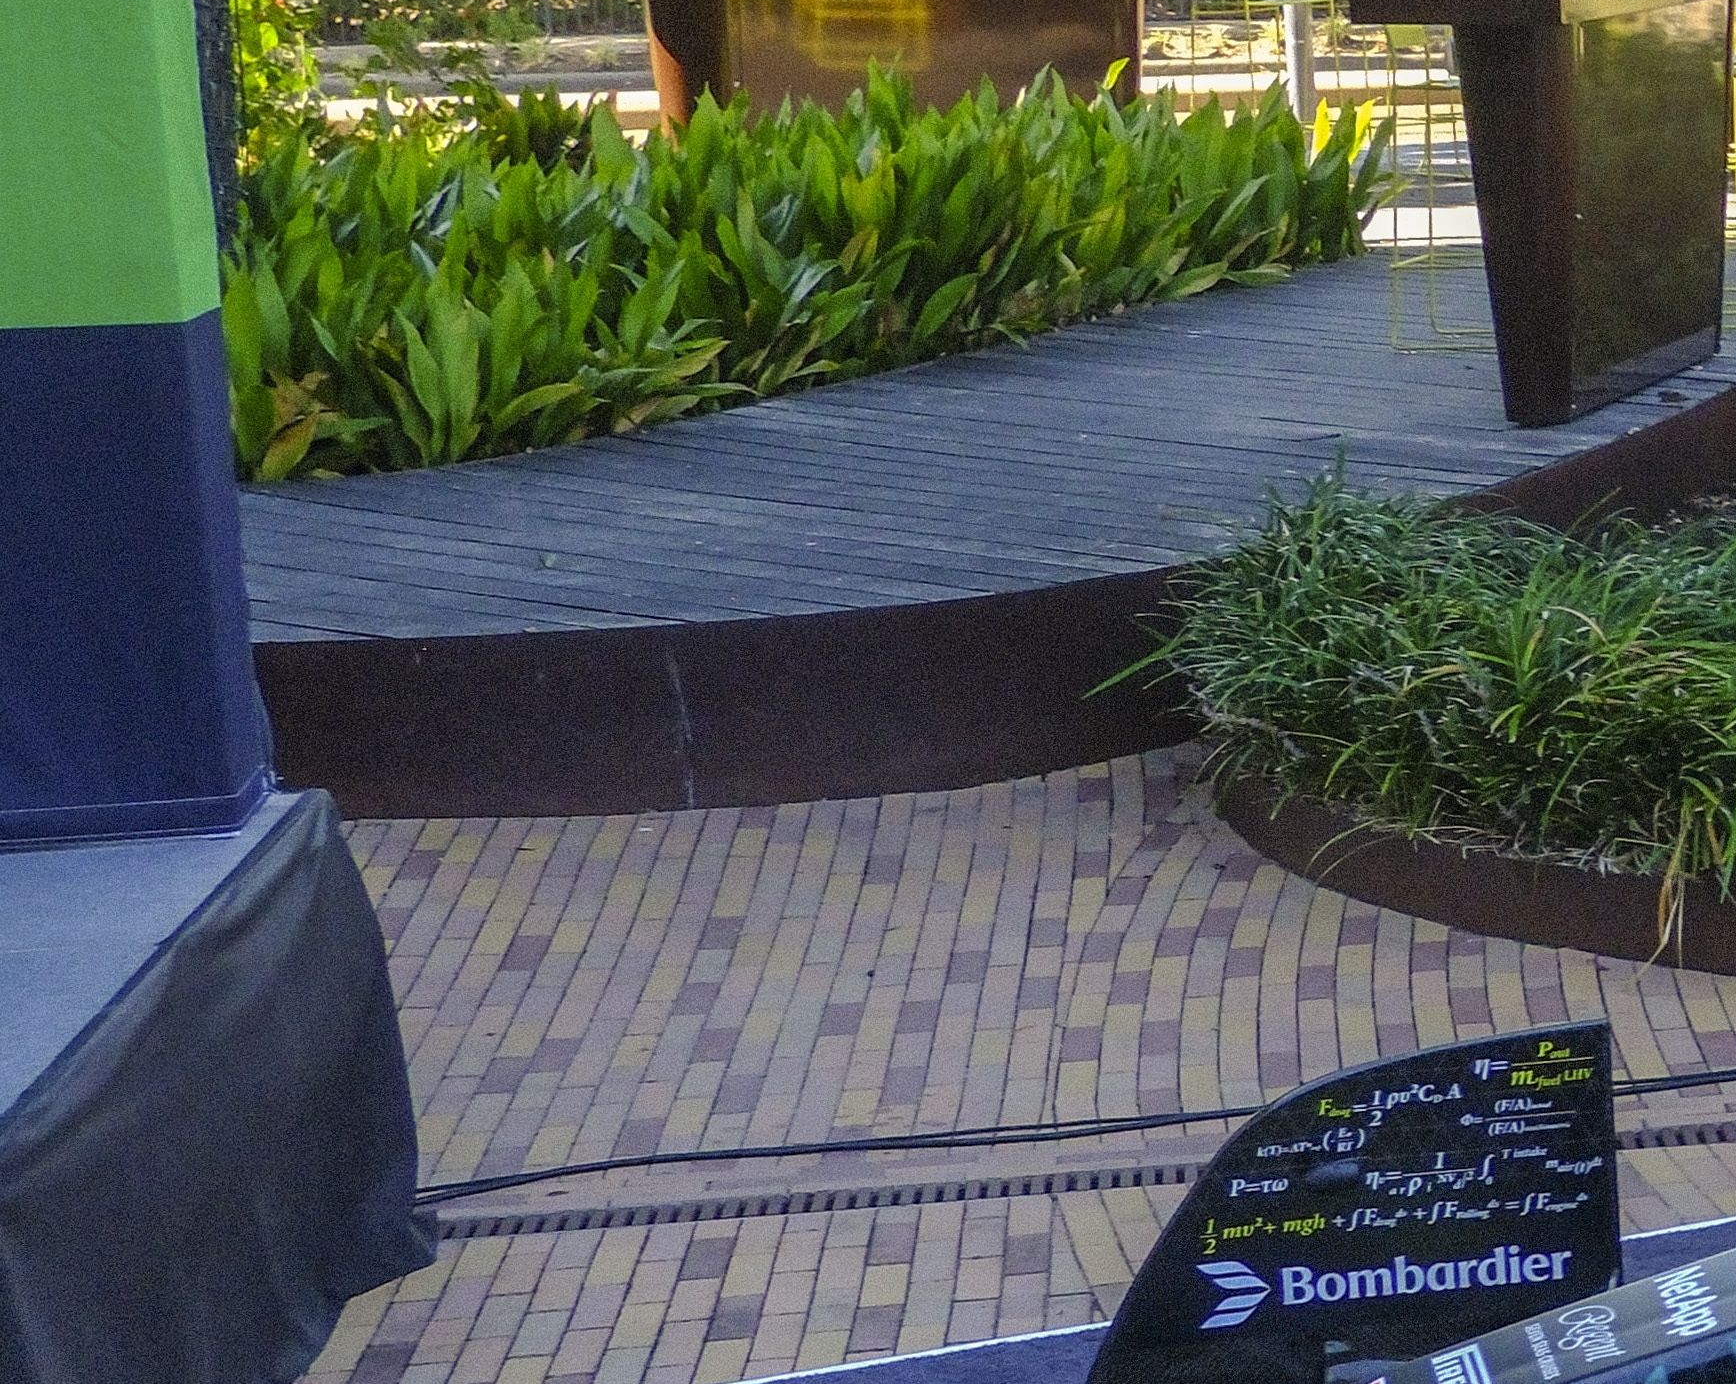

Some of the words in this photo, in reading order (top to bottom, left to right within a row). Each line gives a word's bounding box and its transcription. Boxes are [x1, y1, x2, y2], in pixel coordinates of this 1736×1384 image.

[1280, 1243, 1574, 1308] Bombardier
[1652, 1267, 1720, 1339] NetApp
[1557, 1304, 1628, 1363] Regent
